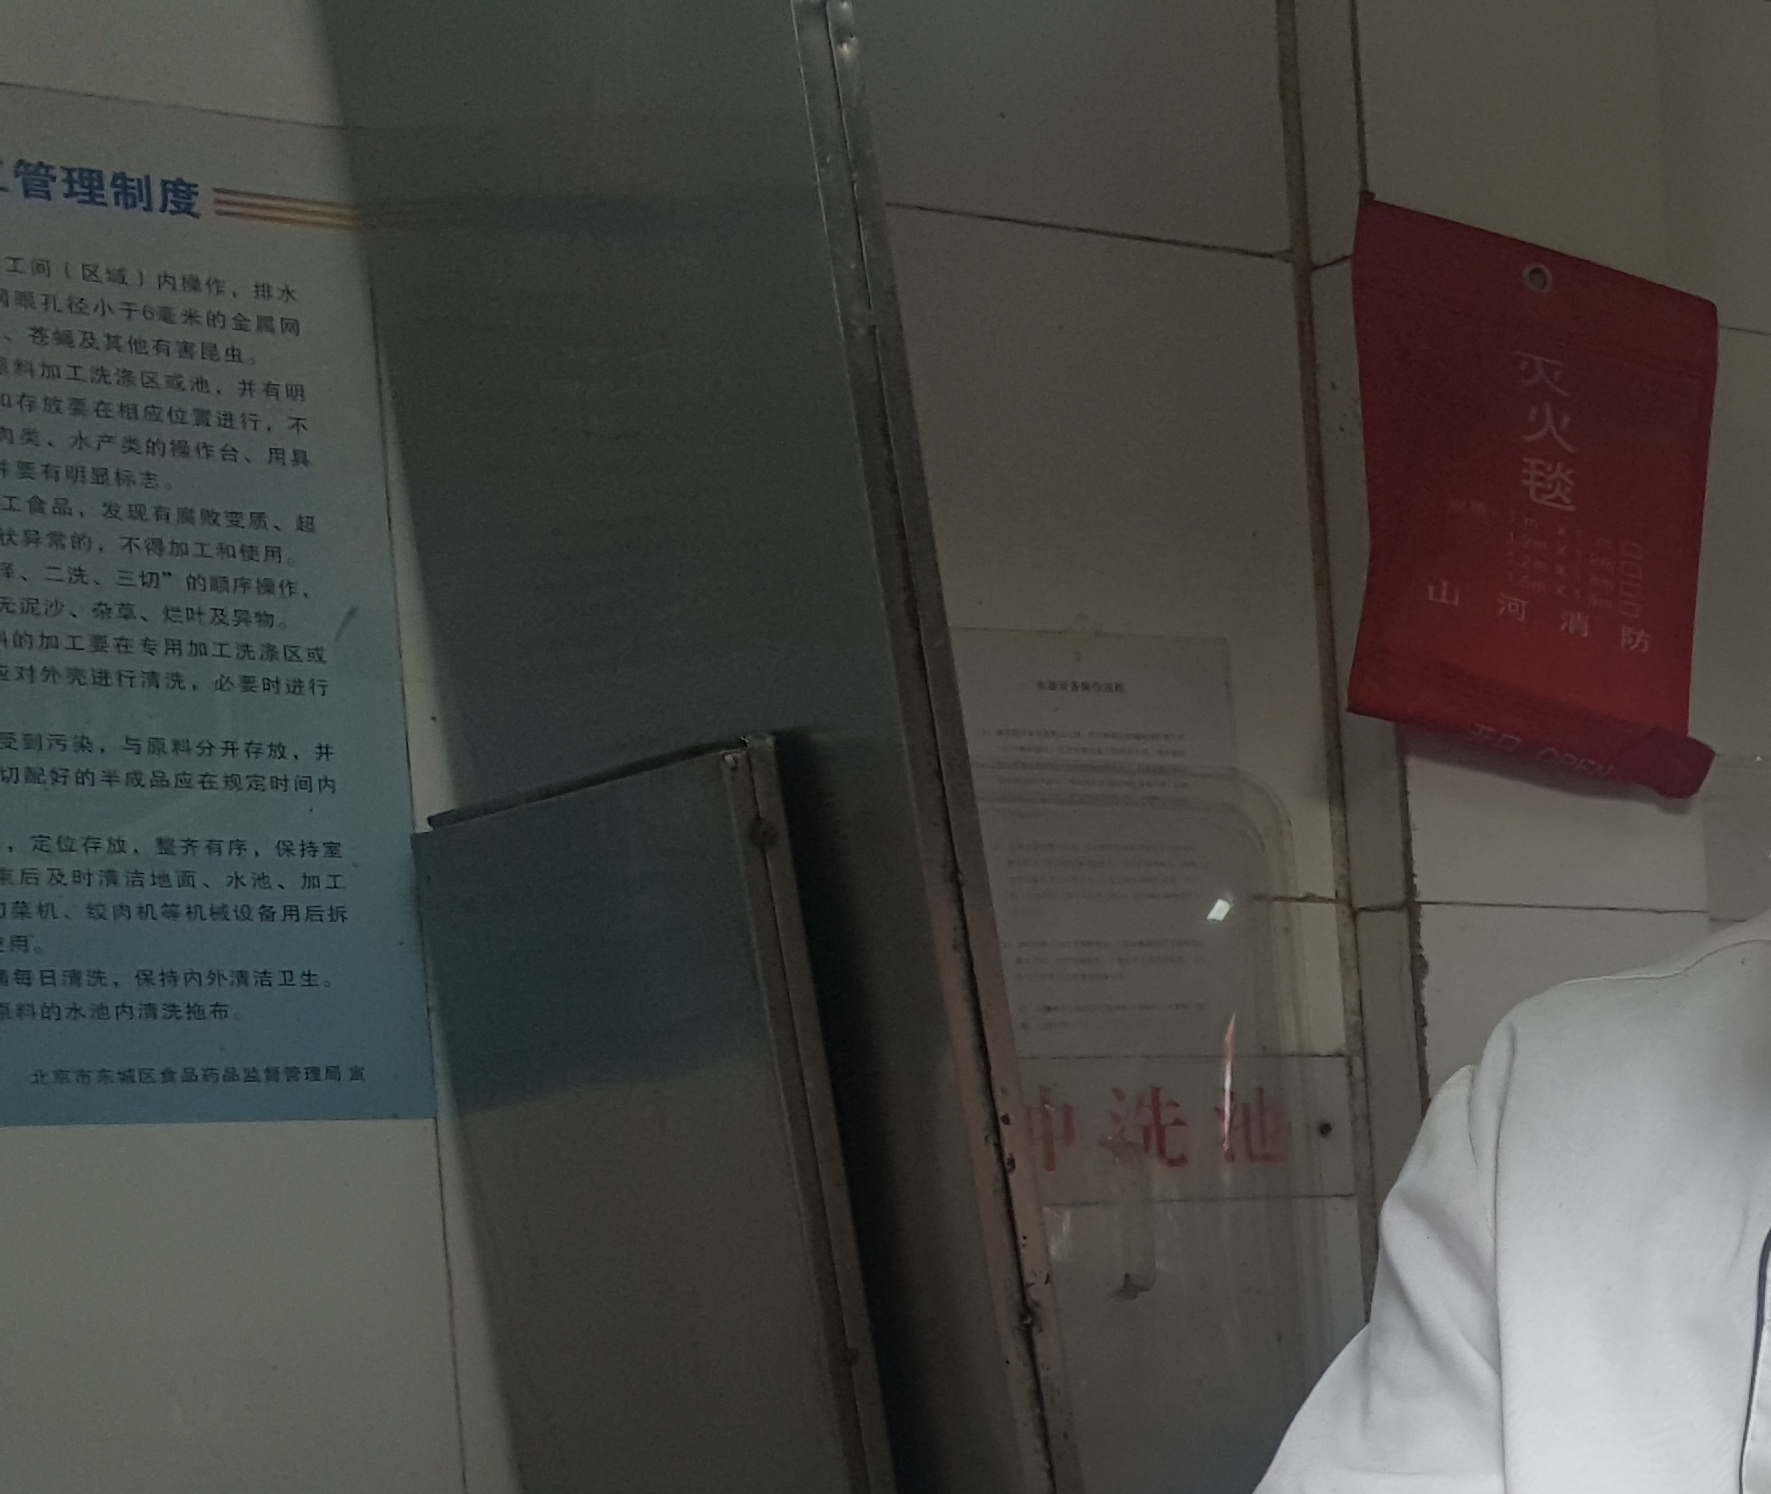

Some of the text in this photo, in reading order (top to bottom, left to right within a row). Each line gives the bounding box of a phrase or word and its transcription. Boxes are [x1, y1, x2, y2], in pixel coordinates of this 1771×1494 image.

[1511, 349, 1579, 513] 灭火毯
[0, 766, 337, 795] 切配好的半成品应在规定时间内
[0, 934, 45, 955] 用。
